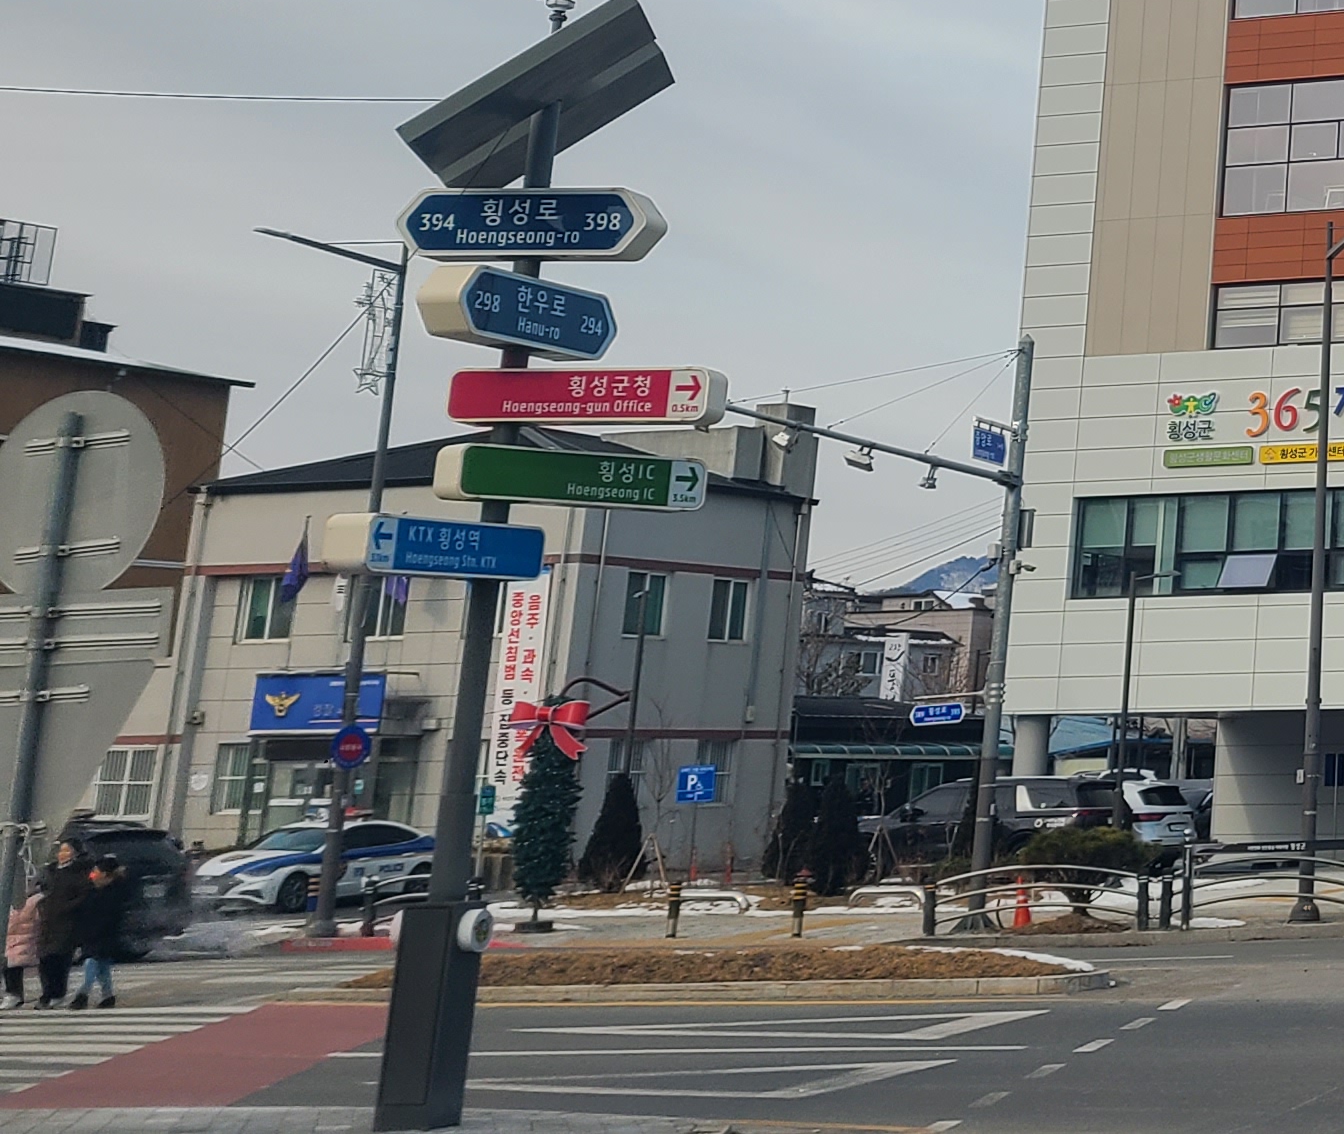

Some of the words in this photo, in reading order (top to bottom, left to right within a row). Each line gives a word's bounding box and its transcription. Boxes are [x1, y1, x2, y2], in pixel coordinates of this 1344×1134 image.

[418, 213, 455, 231] 394
[480, 198, 559, 226] 횡성로
[583, 212, 622, 231] 398
[455, 228, 580, 247] Hoengseong-ro
[474, 290, 501, 313] 298
[517, 285, 567, 317] 한우로
[517, 316, 561, 340] Hanu-ro
[580, 315, 603, 337] 294
[567, 375, 652, 398] 횡성군청
[502, 400, 610, 415] Hoengseong-gun
[613, 399, 653, 413] Office
[671, 403, 699, 413] 0.5km
[1246, 387, 1322, 438] 365
[1166, 420, 1215, 442] 횡성군
[1279, 447, 1308, 459] 횡성군
[598, 461, 656, 483] 횡성IC
[567, 482, 640, 501] Hoengseong
[643, 487, 656, 501] IC
[672, 494, 697, 504] 3.5km
[408, 525, 435, 543] KTX
[438, 527, 481, 551] 횡성역
[405, 551, 460, 569] Hoengseong
[526, 594, 541, 629] 음주
[503, 591, 525, 681] 중앙선침범
[520, 648, 537, 684] 과속
[500, 688, 515, 706] 등
